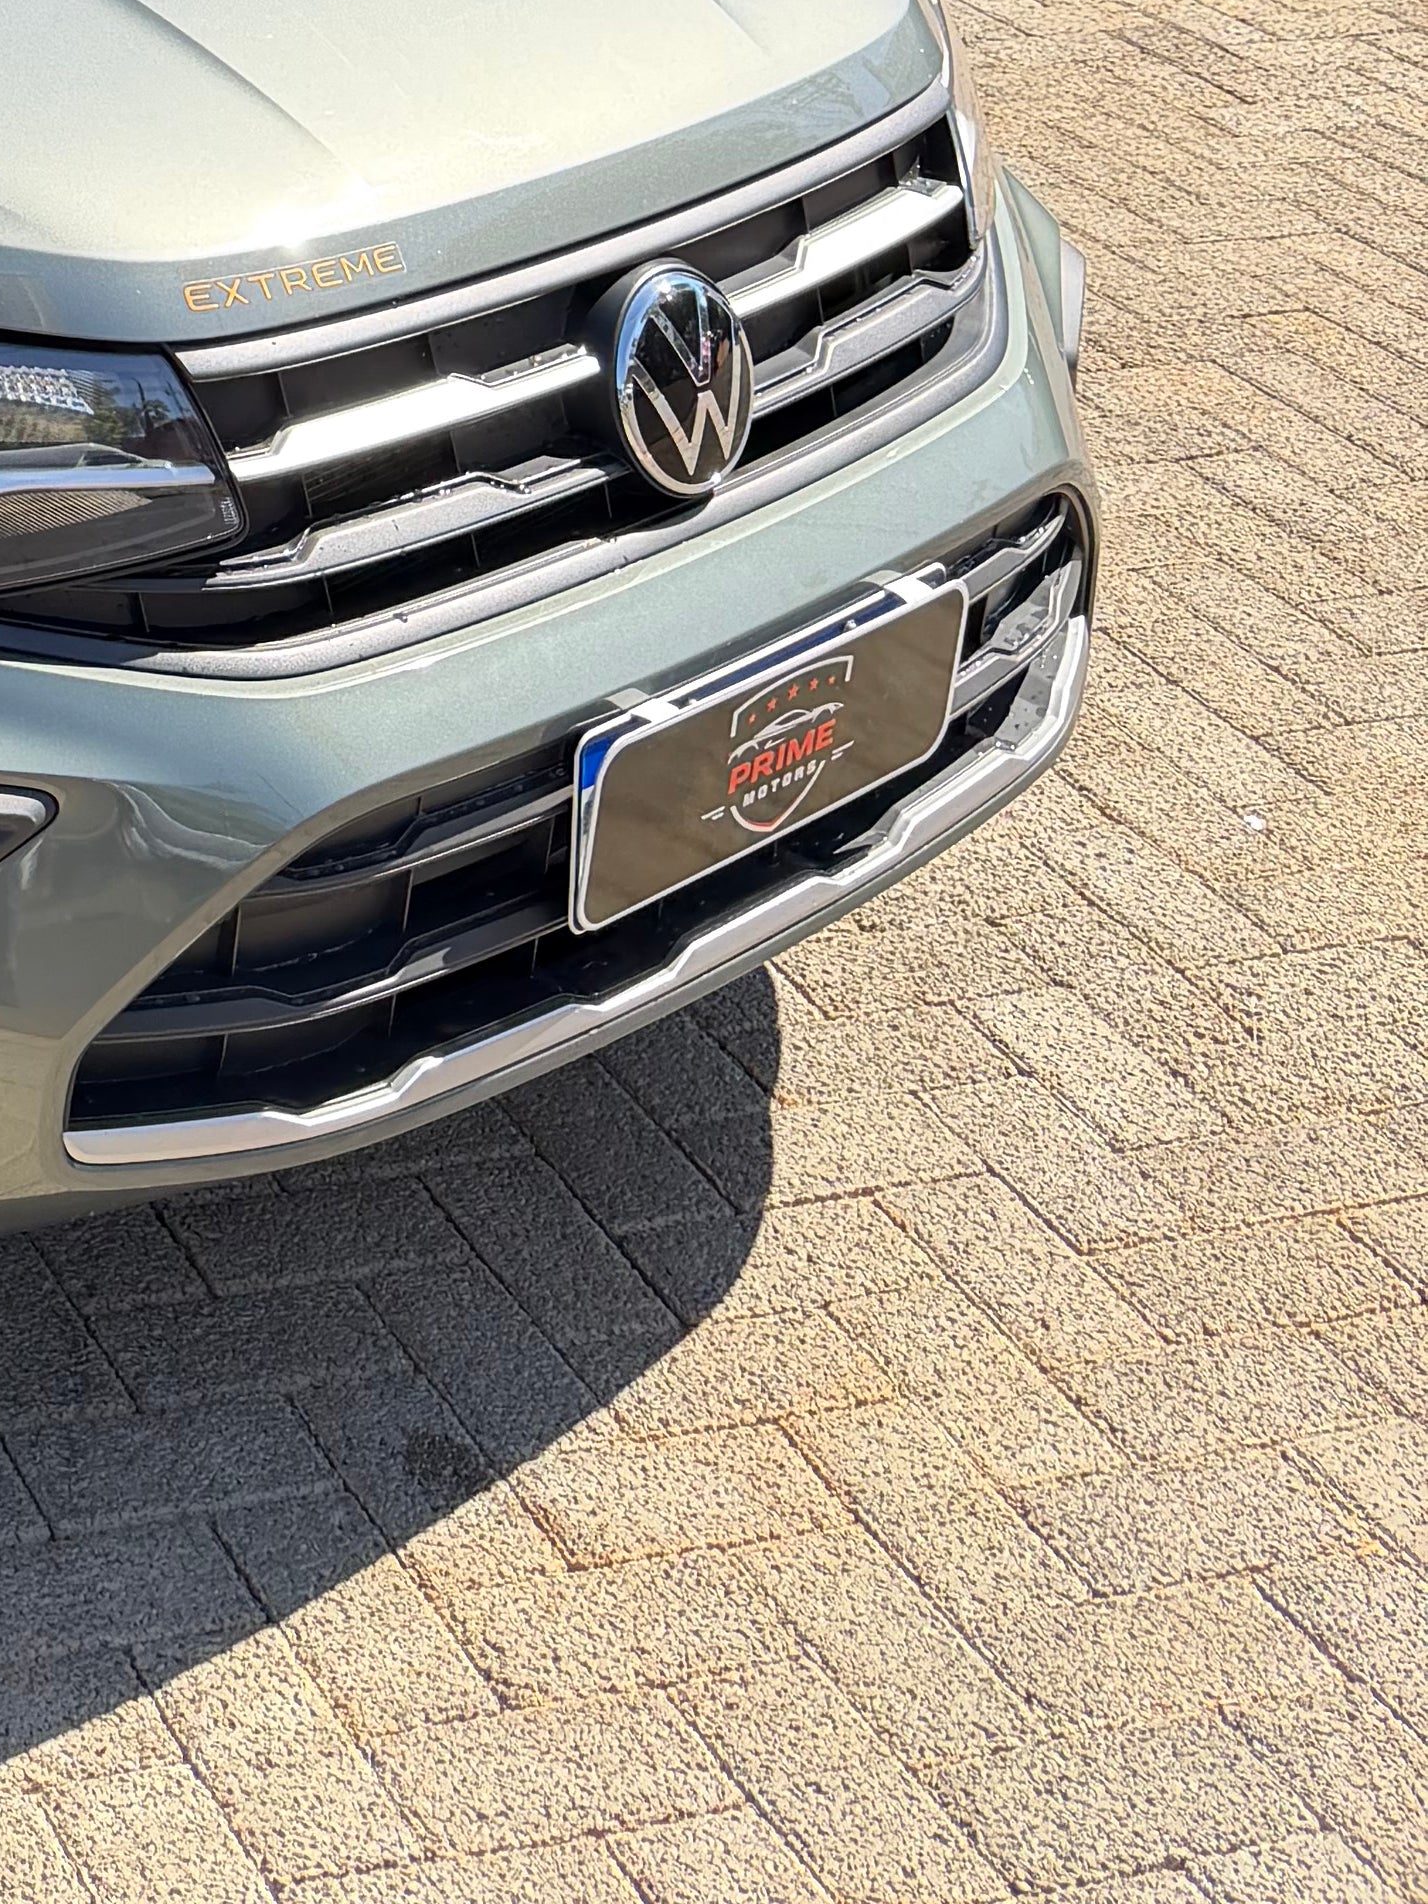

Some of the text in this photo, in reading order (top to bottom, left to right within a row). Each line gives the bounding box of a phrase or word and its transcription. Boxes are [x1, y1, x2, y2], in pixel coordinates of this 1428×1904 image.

[183, 244, 403, 312] EXTREME
[619, 274, 752, 492] VW
[727, 718, 836, 795] PRIME
[742, 759, 817, 807] MOTORS
